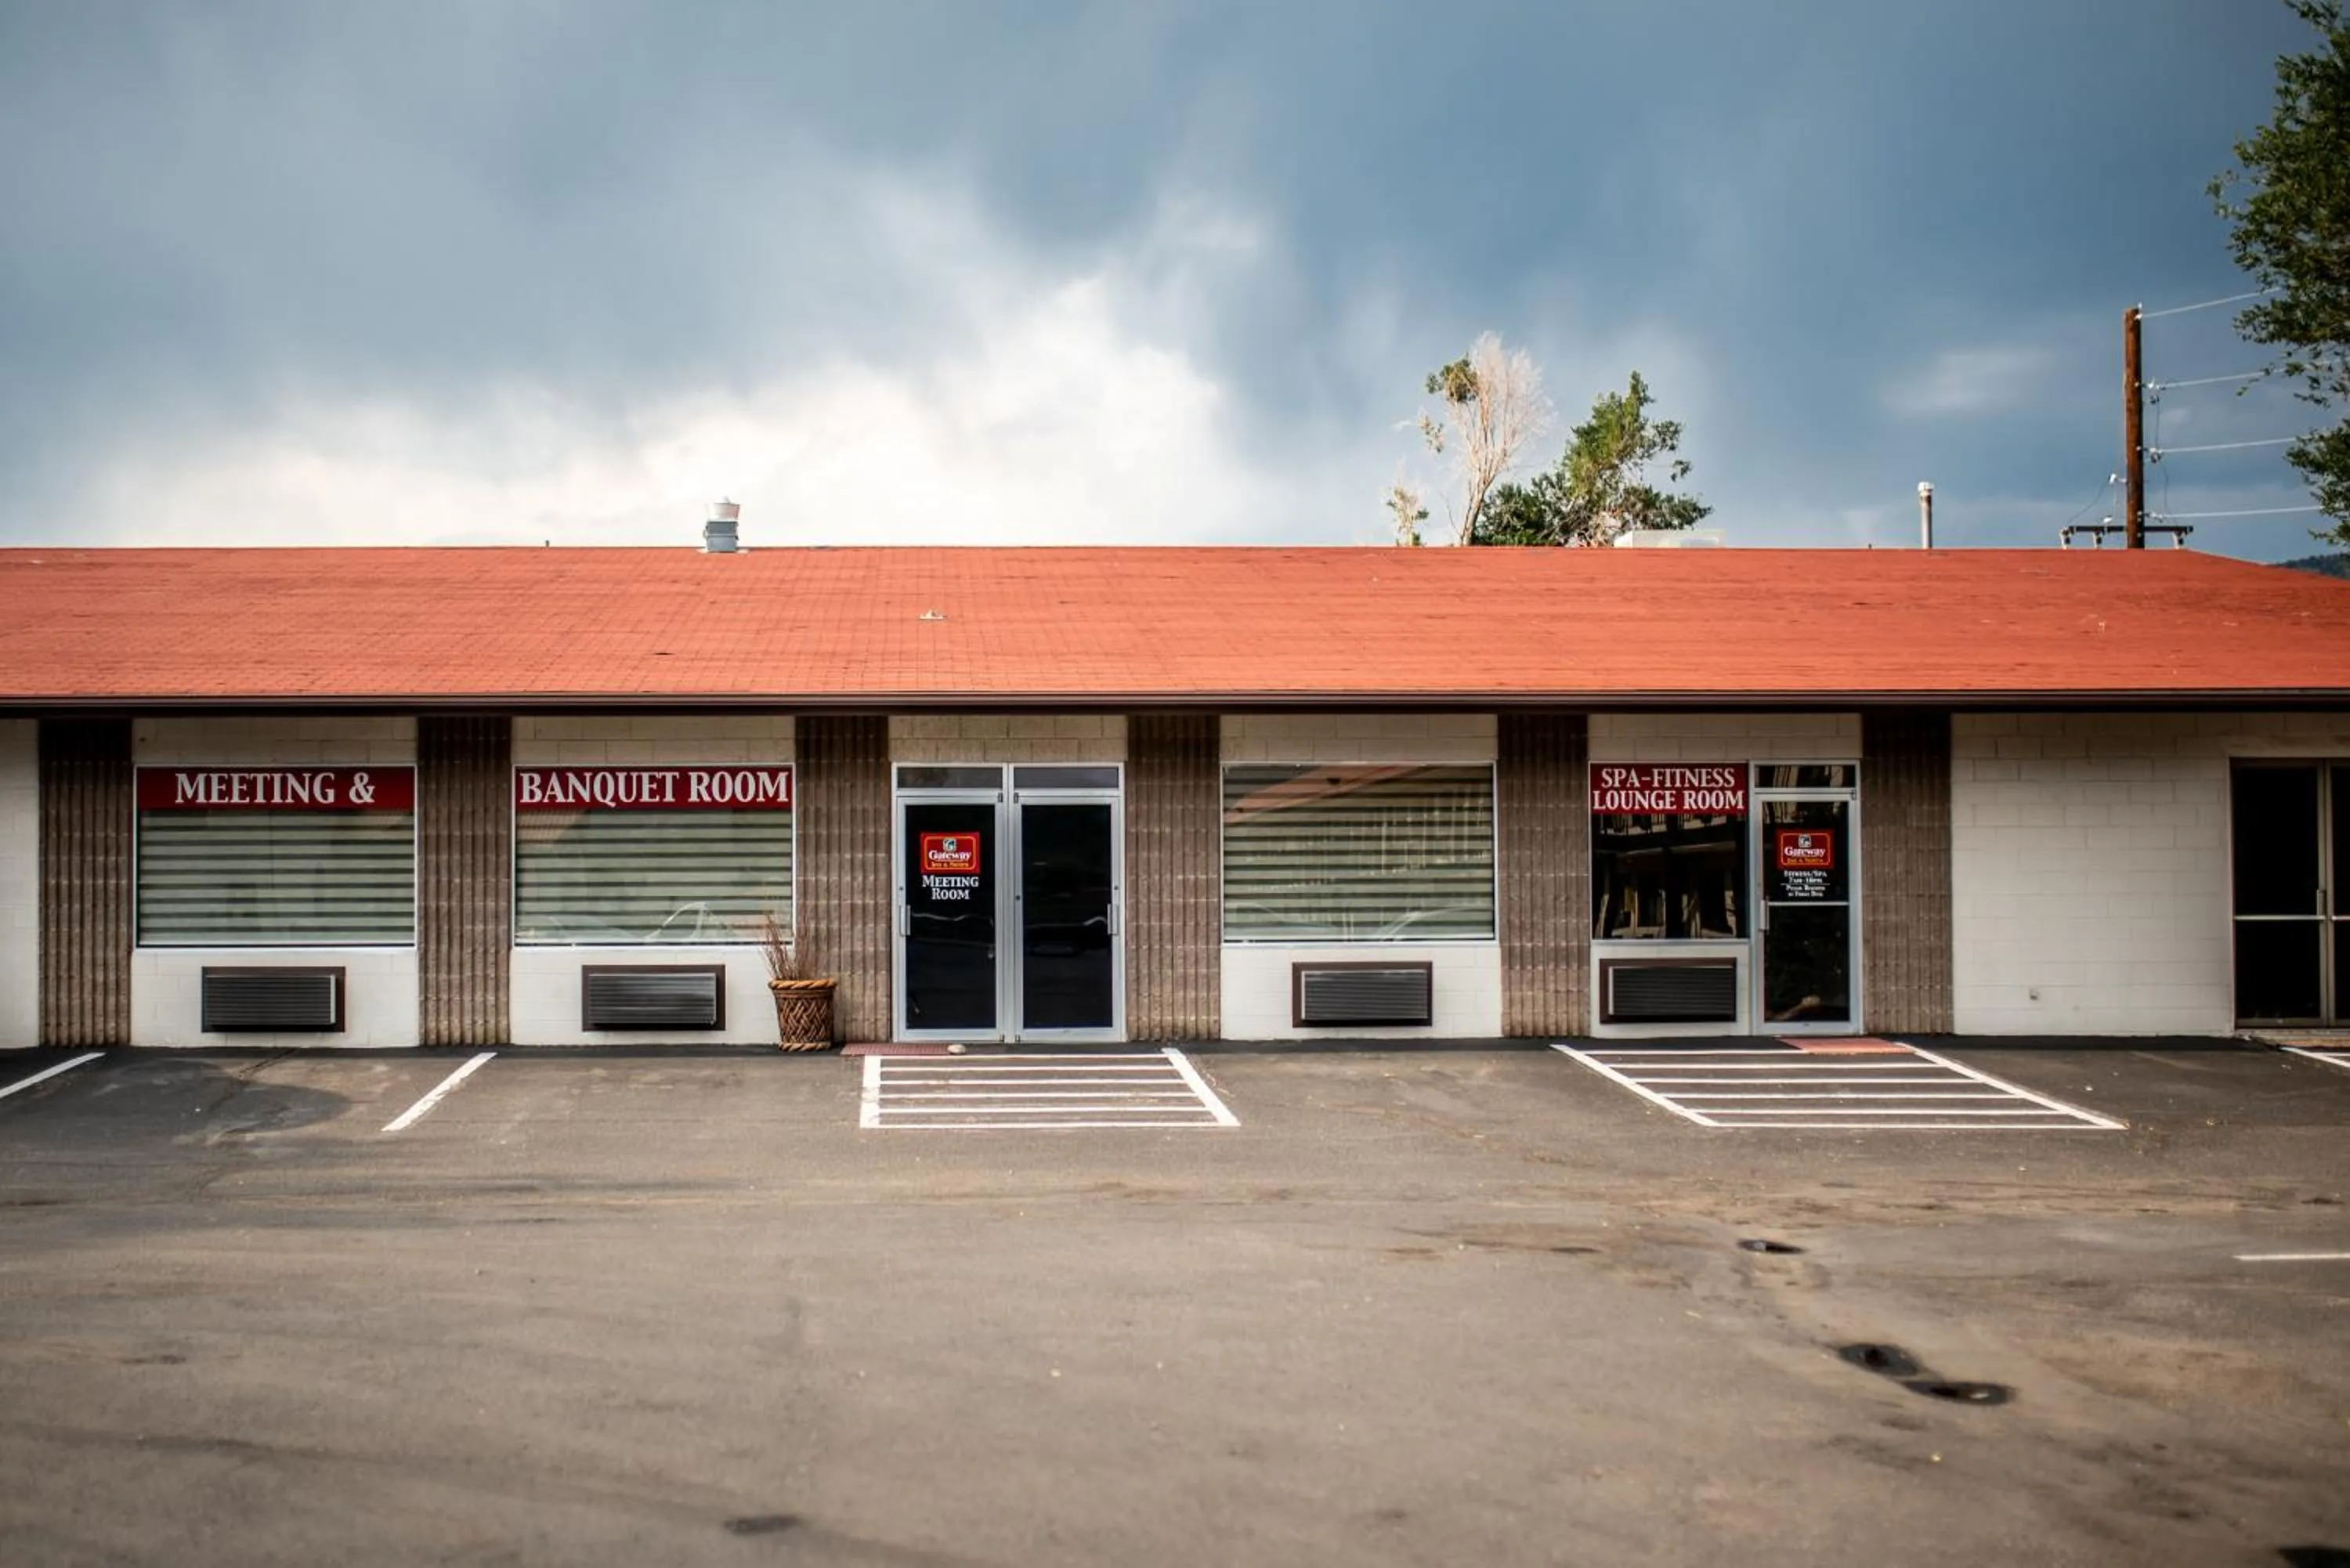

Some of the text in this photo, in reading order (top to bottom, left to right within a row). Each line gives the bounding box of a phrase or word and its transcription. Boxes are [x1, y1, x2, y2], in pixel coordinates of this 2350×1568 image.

[1600, 768, 1735, 788] SPA-FITNESS
[175, 771, 376, 804] MEETING &
[519, 771, 789, 807] BANQUET ROOM
[1593, 789, 1744, 810] LOUNGE ROOM
[928, 850, 972, 861] Gateway
[1784, 846, 1826, 858] Gateway
[922, 874, 979, 887] MEETING
[931, 887, 970, 900] ROOM
